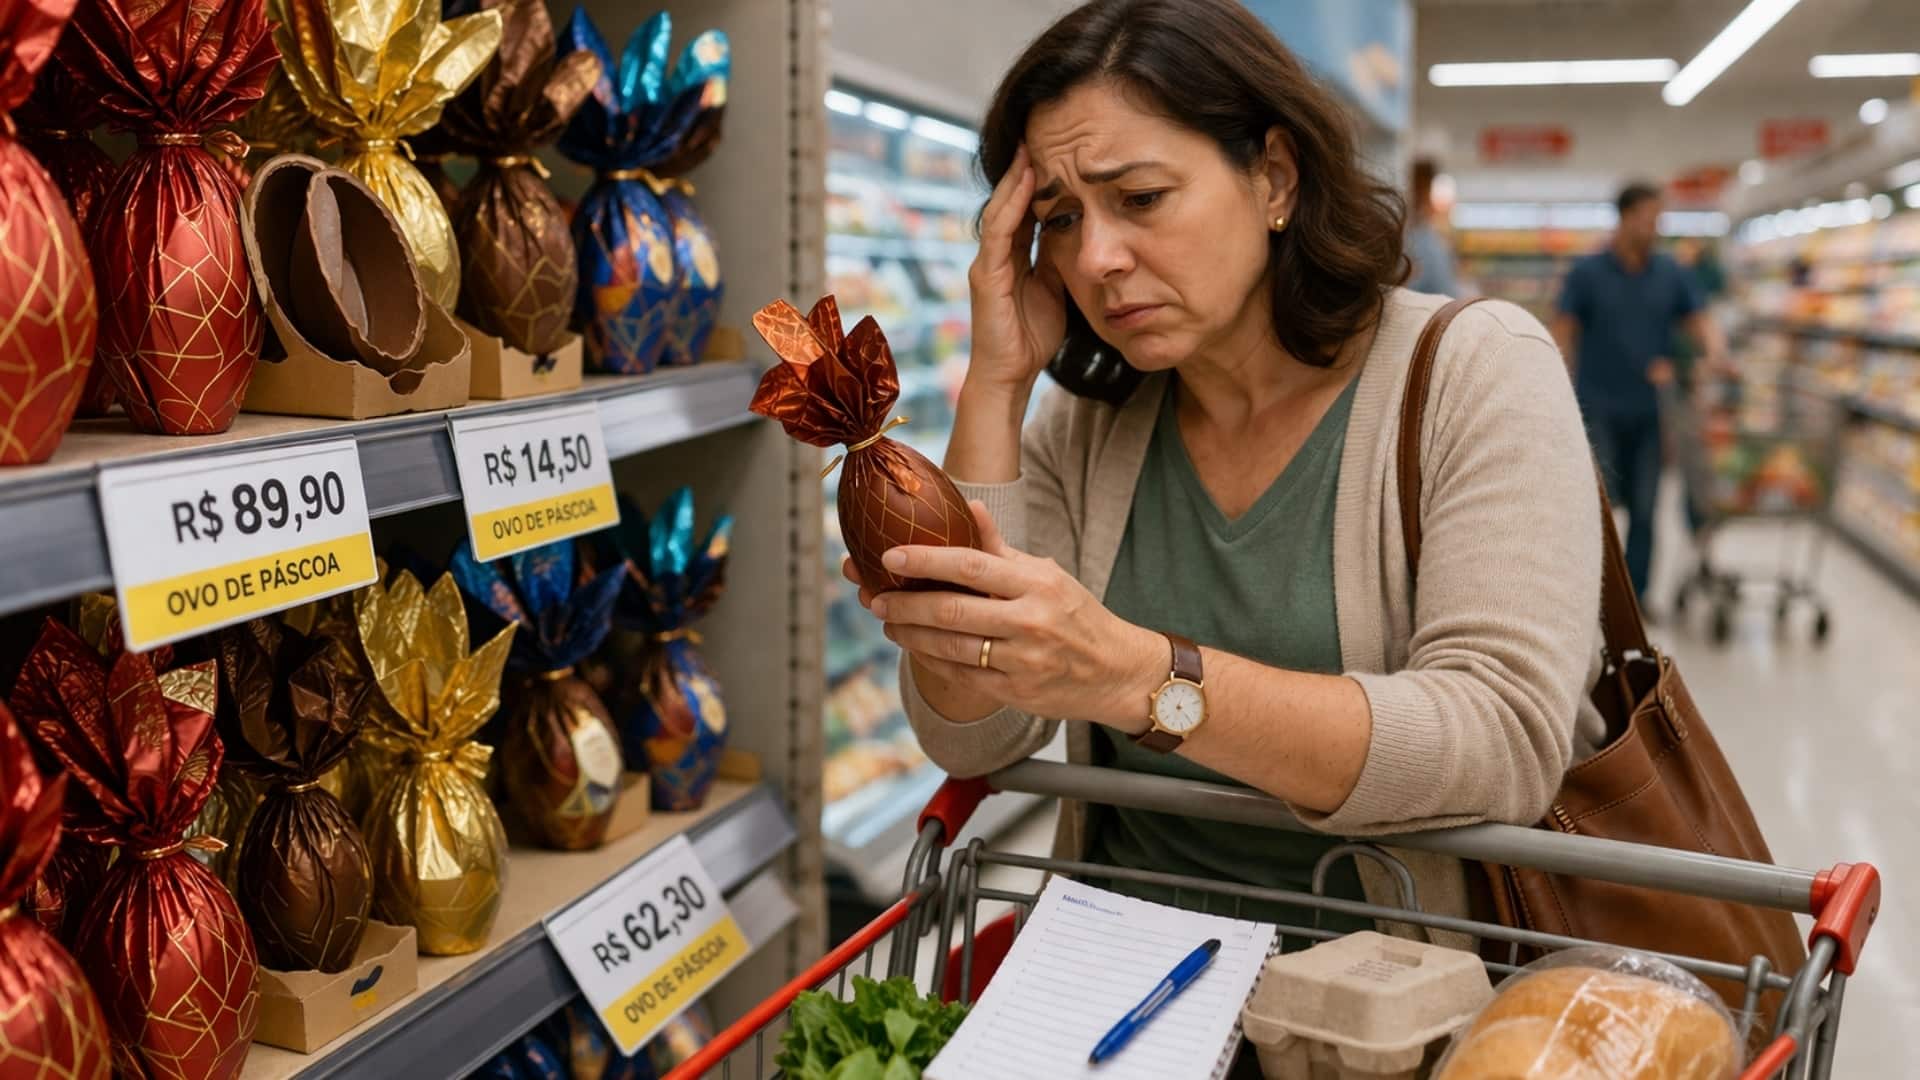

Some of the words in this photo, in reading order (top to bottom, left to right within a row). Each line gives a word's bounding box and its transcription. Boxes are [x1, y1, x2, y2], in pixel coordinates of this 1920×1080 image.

[484, 445, 517, 486] R$
[521, 434, 592, 483] 14,50
[171, 490, 224, 543] R$
[232, 471, 345, 535] 89,90
[493, 516, 523, 540] OVO
[525, 510, 544, 531] DE
[546, 498, 597, 525] PÁSCOA
[167, 583, 218, 616] OVO
[224, 573, 255, 601] DE
[259, 552, 341, 592] PÁSCOA
[592, 931, 631, 973] R$
[623, 876, 706, 949] 62,30
[624, 991, 656, 1024] OVO
[653, 976, 677, 1001] DE
